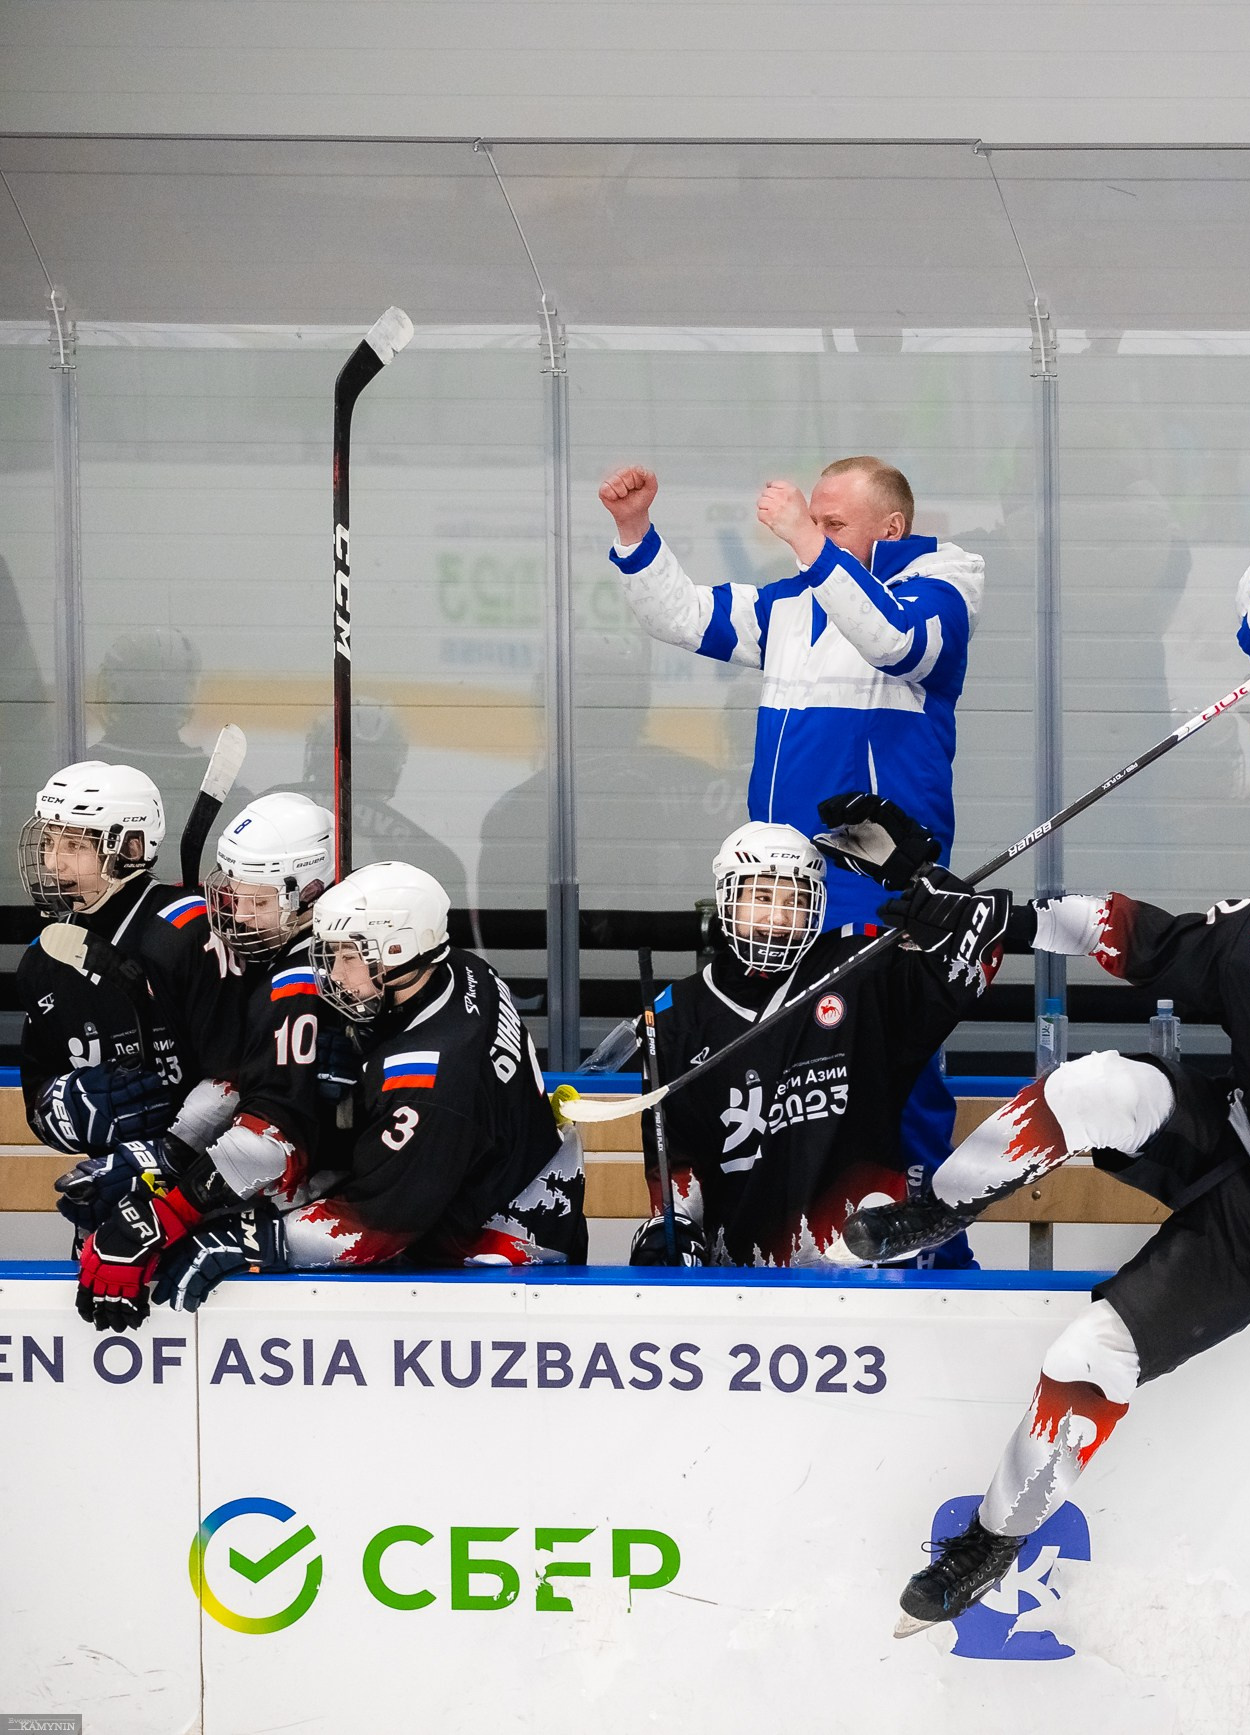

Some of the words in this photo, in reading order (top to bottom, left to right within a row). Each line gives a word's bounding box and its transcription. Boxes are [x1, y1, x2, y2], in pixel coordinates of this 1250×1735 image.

[335, 523, 351, 661] CCM
[41, 795, 64, 804] CCM
[122, 815, 147, 823] CCM
[233, 818, 252, 834] 8
[770, 852, 801, 860] CCM
[1008, 821, 1052, 857] BAUER
[295, 855, 325, 869] BAUER
[274, 1013, 318, 1065] 10
[805, 1065, 847, 1085] Азии
[768, 1084, 849, 1135] 2023
[381, 1105, 419, 1151] 3
[93, 1335, 187, 1384] OF
[209, 1337, 368, 1387] ASIA
[393, 1338, 704, 1391] KUZBASS
[728, 1343, 888, 1394] 2023
[362, 1524, 682, 1613] СБЕР
